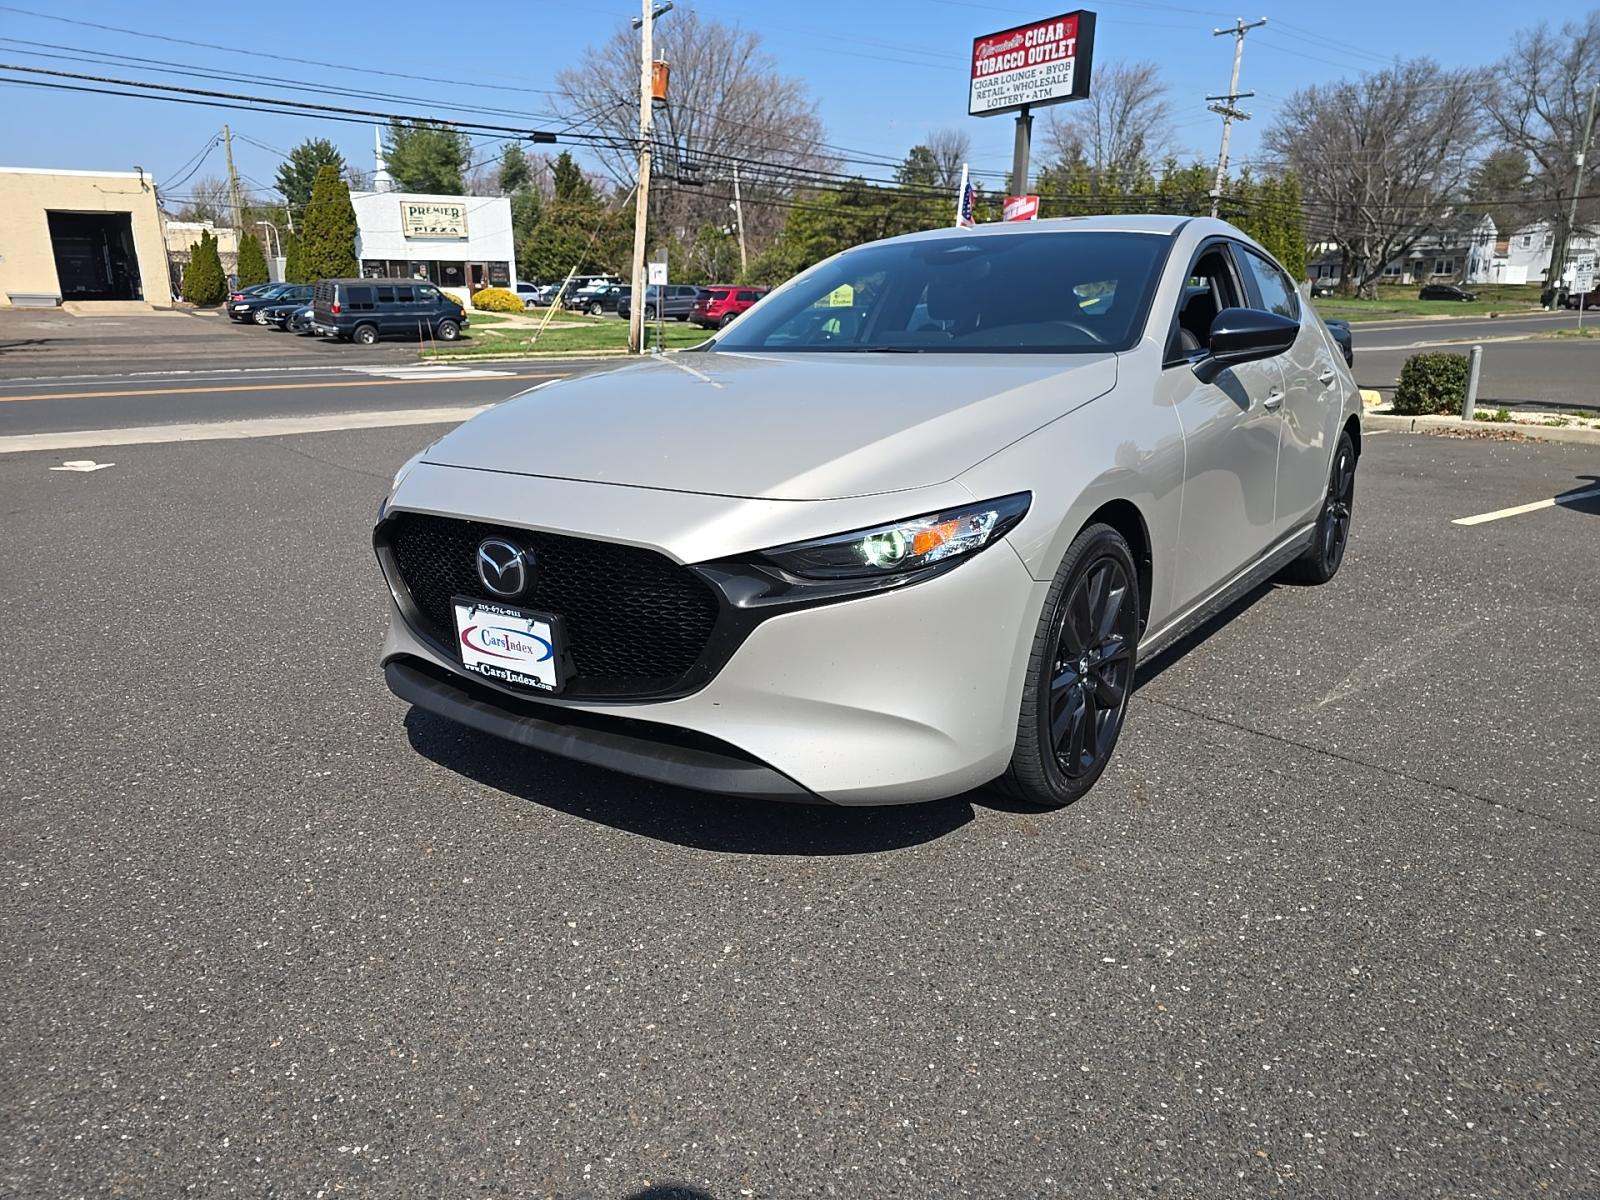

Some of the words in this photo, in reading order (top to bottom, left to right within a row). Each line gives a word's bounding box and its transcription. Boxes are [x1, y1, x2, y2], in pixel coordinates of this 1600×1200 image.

[1024, 22, 1064, 48] CIGAR
[975, 50, 1025, 76] TOBACCO
[1027, 38, 1076, 64] OUTLET
[973, 77, 999, 90] CIGAR
[1000, 69, 1036, 85] LOUNGE
[1046, 62, 1071, 75] BYOB
[976, 87, 1006, 100] RETAIL
[1013, 73, 1069, 92] WHOLESALE
[987, 93, 1025, 108] LOTTERY
[1031, 88, 1053, 100] ATM
[409, 206, 460, 218] PREMIER
[481, 629, 534, 655] CarsIndex
